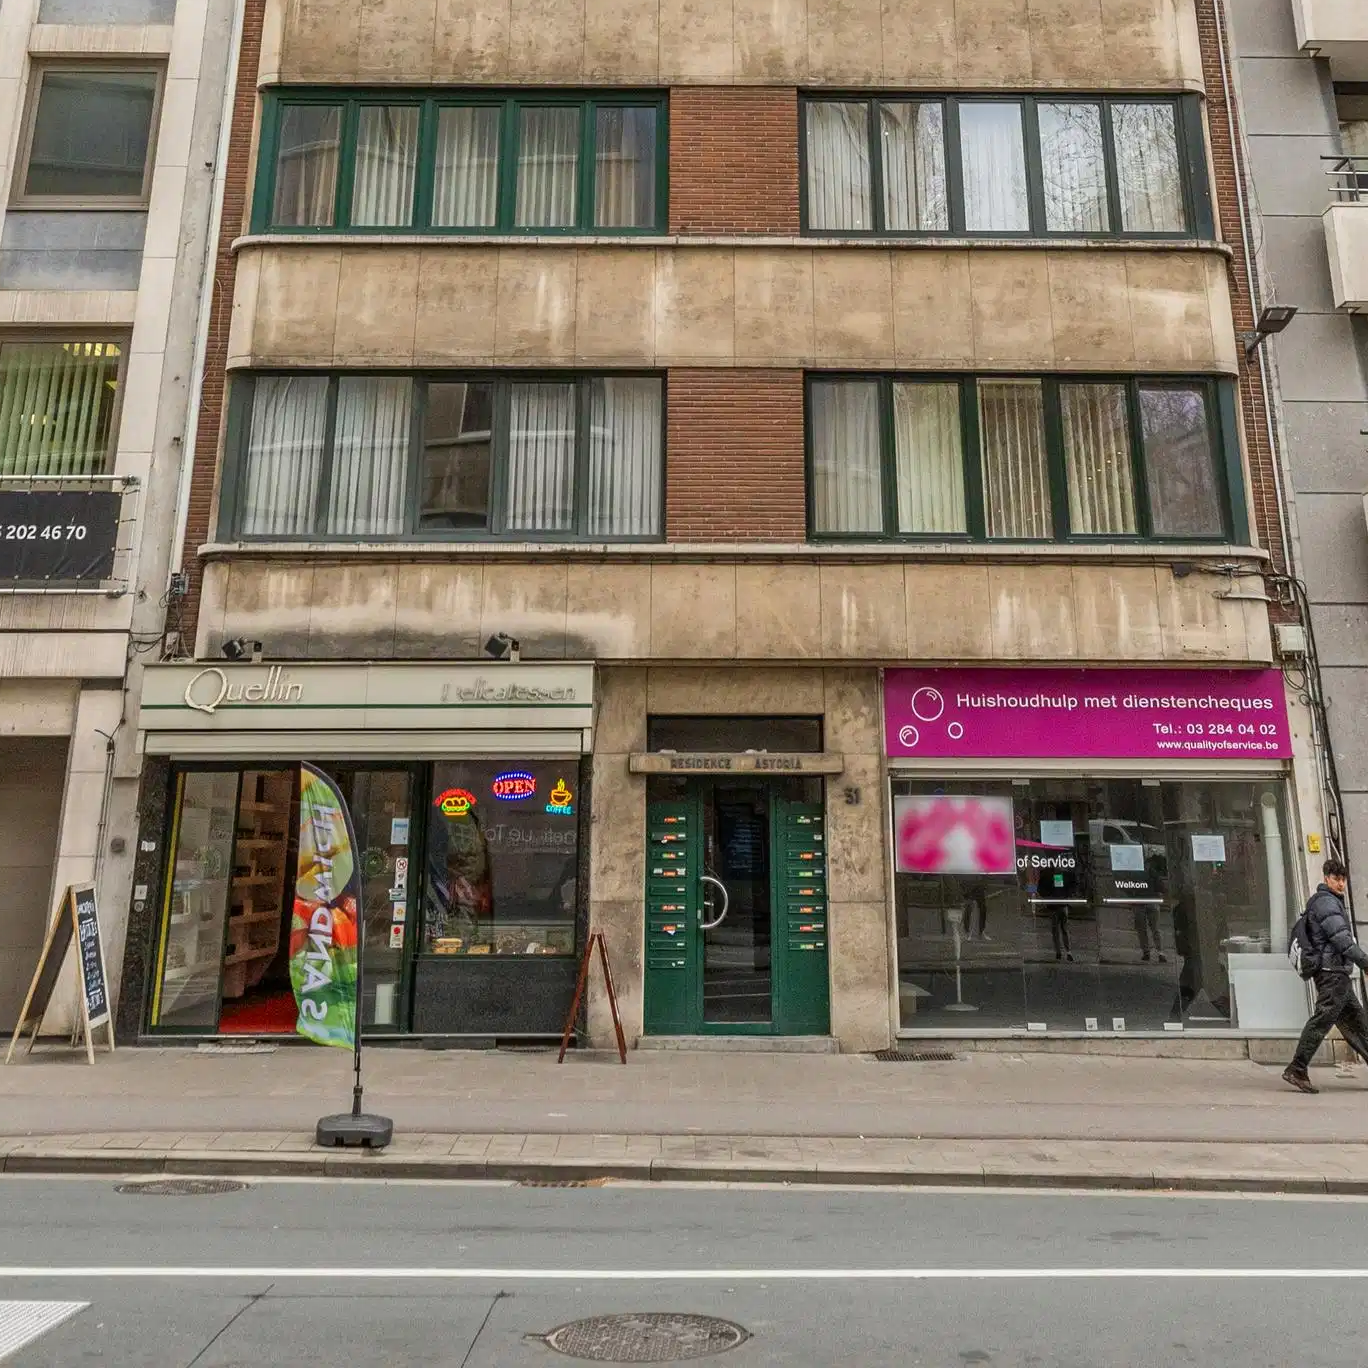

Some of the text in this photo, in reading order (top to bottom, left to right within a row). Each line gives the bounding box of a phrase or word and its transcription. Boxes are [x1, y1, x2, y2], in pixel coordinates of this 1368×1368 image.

[6, 525, 36, 540] 202
[40, 525, 62, 540] 46
[65, 525, 86, 540] 70
[185, 665, 304, 713] Quellin
[956, 694, 1273, 711] Huishoudhulp met dienstencheques
[1153, 723, 1277, 736] Tel.: 03 284 04 02
[1157, 740, 1278, 751] www.qualityofservice.be
[670, 757, 802, 770] RESIDENCE ASTORIA
[493, 779, 536, 794] OPEN
[545, 805, 573, 815] COFFEE
[1017, 855, 1076, 868] of Service
[1115, 881, 1148, 889] Welkom
